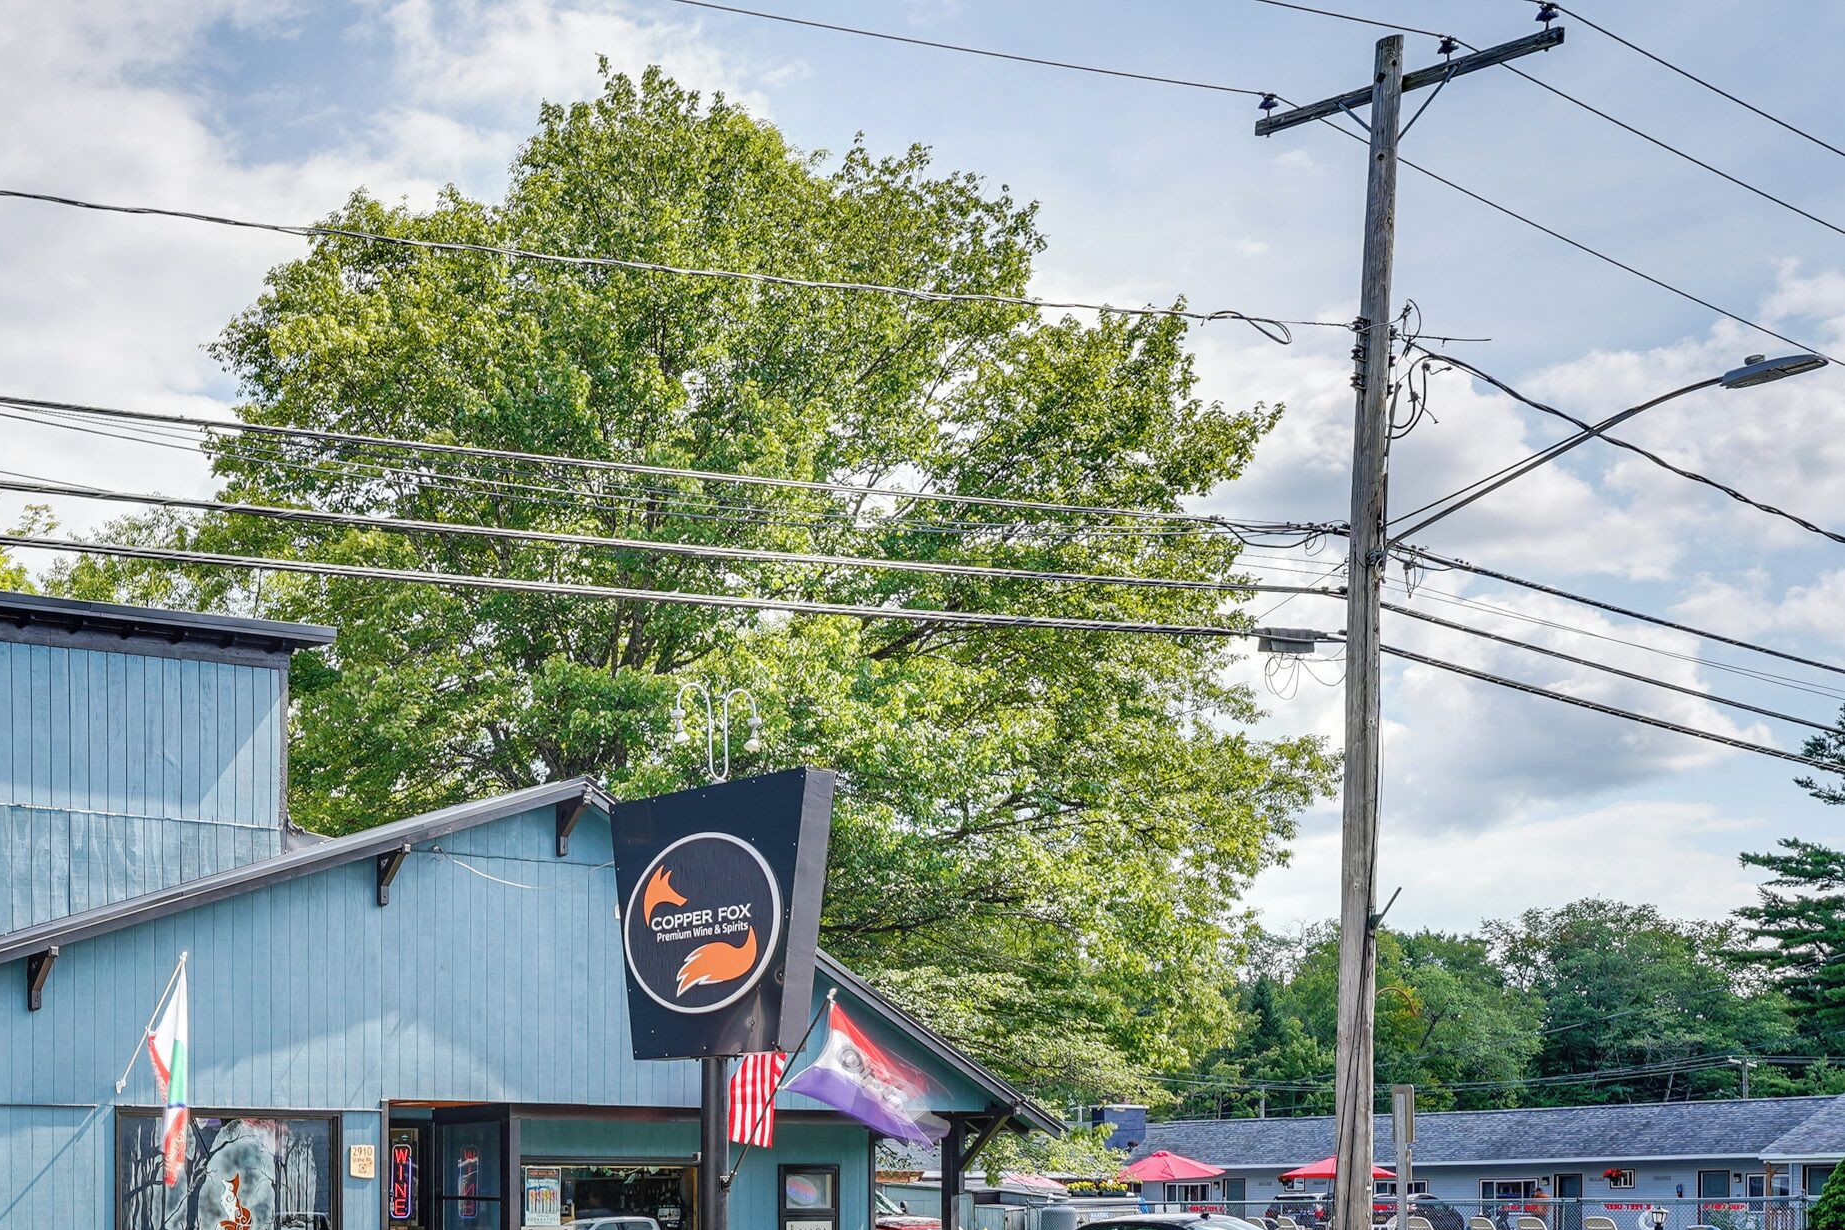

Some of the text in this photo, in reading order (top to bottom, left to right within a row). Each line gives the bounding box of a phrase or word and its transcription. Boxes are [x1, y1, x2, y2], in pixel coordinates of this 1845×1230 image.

[651, 903, 752, 931] COPPER FOX
[657, 920, 749, 943] Premium Wine & Spirits
[353, 1147, 373, 1156] 2910
[394, 1148, 409, 1216] WINE
